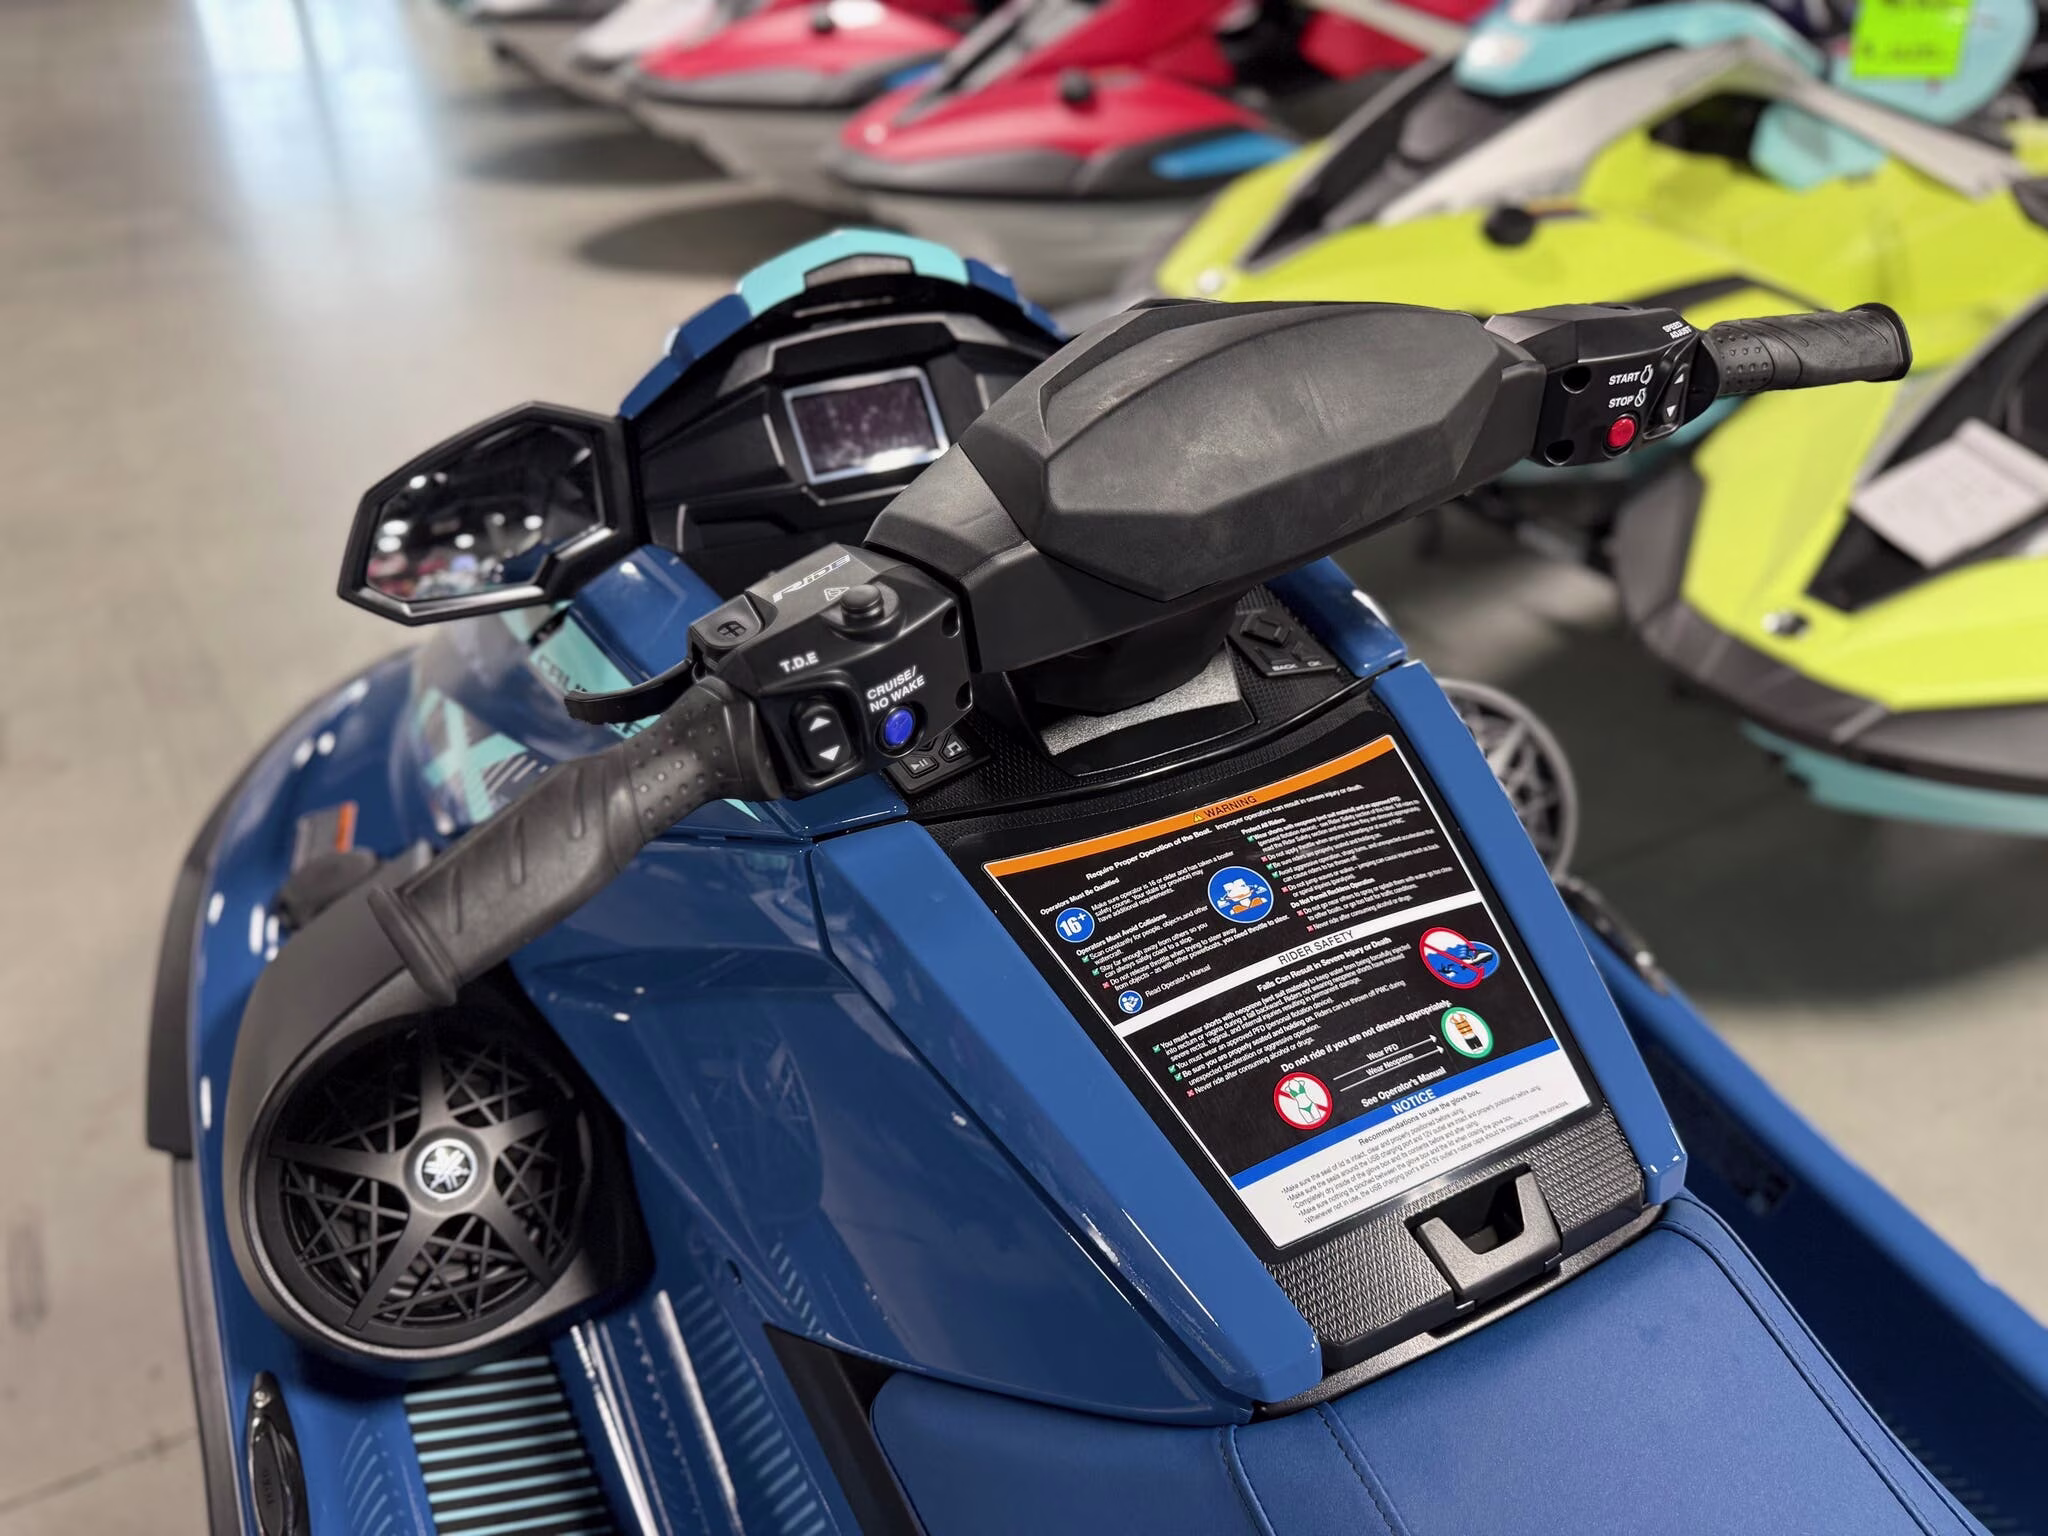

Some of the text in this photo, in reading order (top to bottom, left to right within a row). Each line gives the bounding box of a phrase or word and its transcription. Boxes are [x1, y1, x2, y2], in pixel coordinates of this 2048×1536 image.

[1662, 321, 1683, 333] SPEED
[1670, 325, 1692, 339] ADJUST
[1608, 371, 1641, 386] START
[1608, 395, 1634, 408] STOP
[779, 651, 820, 673] T.D.E
[867, 665, 917, 700] CRUISE/
[869, 675, 926, 713] NO WAKE
[1203, 795, 1257, 818] WARNING
[1085, 864, 1114, 879] Require
[1113, 855, 1139, 868] Proper
[1138, 841, 1173, 858] Operation
[1173, 837, 1182, 845] of
[1180, 834, 1193, 842] the
[1192, 827, 1212, 838] Boat.
[1214, 816, 1243, 830] Improper
[1243, 808, 1272, 820] operation
[1283, 799, 1300, 808] result
[1039, 876, 1120, 915] Operators Must Be Qualified
[1090, 900, 1107, 910] Make
[1106, 895, 1119, 904] sure
[1119, 885, 1143, 899] operator
[1148, 879, 1156, 887] 16
[1162, 872, 1177, 881] older
[1176, 867, 1188, 875] and
[1196, 858, 1213, 867] taken
[1216, 850, 1234, 860] boater
[1094, 905, 1113, 916] safety
[1111, 898, 1132, 909] course.
[1131, 892, 1146, 901] Your
[1145, 886, 1159, 895] state
[1191, 869, 1204, 877] may
[1060, 912, 1087, 937] 16+
[1075, 913, 1167, 955] Operators Must Avoid Collisions
[1089, 949, 1105, 960] Scan
[1104, 937, 1134, 953] constantly
[1193, 905, 1208, 914] other
[1098, 963, 1114, 972] Stay
[1121, 948, 1143, 962] enough
[1142, 943, 1159, 953] away
[1157, 937, 1171, 946] from
[1171, 929, 1189, 940] others
[1196, 922, 1208, 931] you
[1104, 969, 1116, 978] can
[1135, 953, 1152, 964] safely
[1151, 945, 1168, 957] coast
[1256, 980, 1275, 991] Falls
[1274, 974, 1291, 984] Can
[1290, 964, 1314, 978] Result
[1320, 953, 1345, 966] Severe
[1344, 947, 1364, 957] Injury
[1371, 936, 1392, 948] Death
[1277, 929, 1354, 964] RIDER SAFETY
[1144, 963, 1211, 997] Read Operator's Manual
[1175, 1060, 1188, 1068] You
[1187, 1053, 1203, 1063] must
[1202, 1047, 1218, 1057] wear
[1225, 1030, 1253, 1046] approved
[1252, 1025, 1265, 1034] PFD
[1265, 1013, 1291, 1029] (personal
[1290, 1005, 1313, 1017] flotation
[1181, 1069, 1191, 1077] Be
[1191, 1063, 1205, 1072] sure
[1204, 1057, 1217, 1067] you
[1227, 1042, 1252, 1057] properly
[1251, 1032, 1272, 1045] seated
[1271, 1027, 1283, 1036] and
[1283, 1019, 1305, 1031] holding
[1313, 1008, 1332, 1018] Riders
[1374, 985, 1389, 994] PWC
[1388, 980, 1406, 989] during
[1281, 1000, 1451, 1071] Do not ride if you are not dressed appropriately.
[1188, 1065, 1222, 1085] unexpected
[1222, 1051, 1256, 1069] acceleration
[1263, 1035, 1293, 1051] aggressive
[1292, 1024, 1320, 1038] operation.
[1194, 1082, 1212, 1093] Never
[1212, 1076, 1224, 1085] ride
[1224, 1070, 1238, 1079] after
[1238, 1056, 1269, 1073] consuming
[1268, 1046, 1290, 1059] alcohol
[1296, 1037, 1314, 1047] drugs.
[1366, 1043, 1398, 1060] Wear PFD
[1366, 1053, 1414, 1076] Wear Neoprene
[1361, 1066, 1446, 1107] See Operator's Manual
[1390, 1088, 1436, 1114] NOTICE
[1358, 1115, 1419, 1145] Recommendations
[1427, 1106, 1439, 1115] use
[1450, 1095, 1467, 1106] glove
[1466, 1090, 1479, 1098] box.
